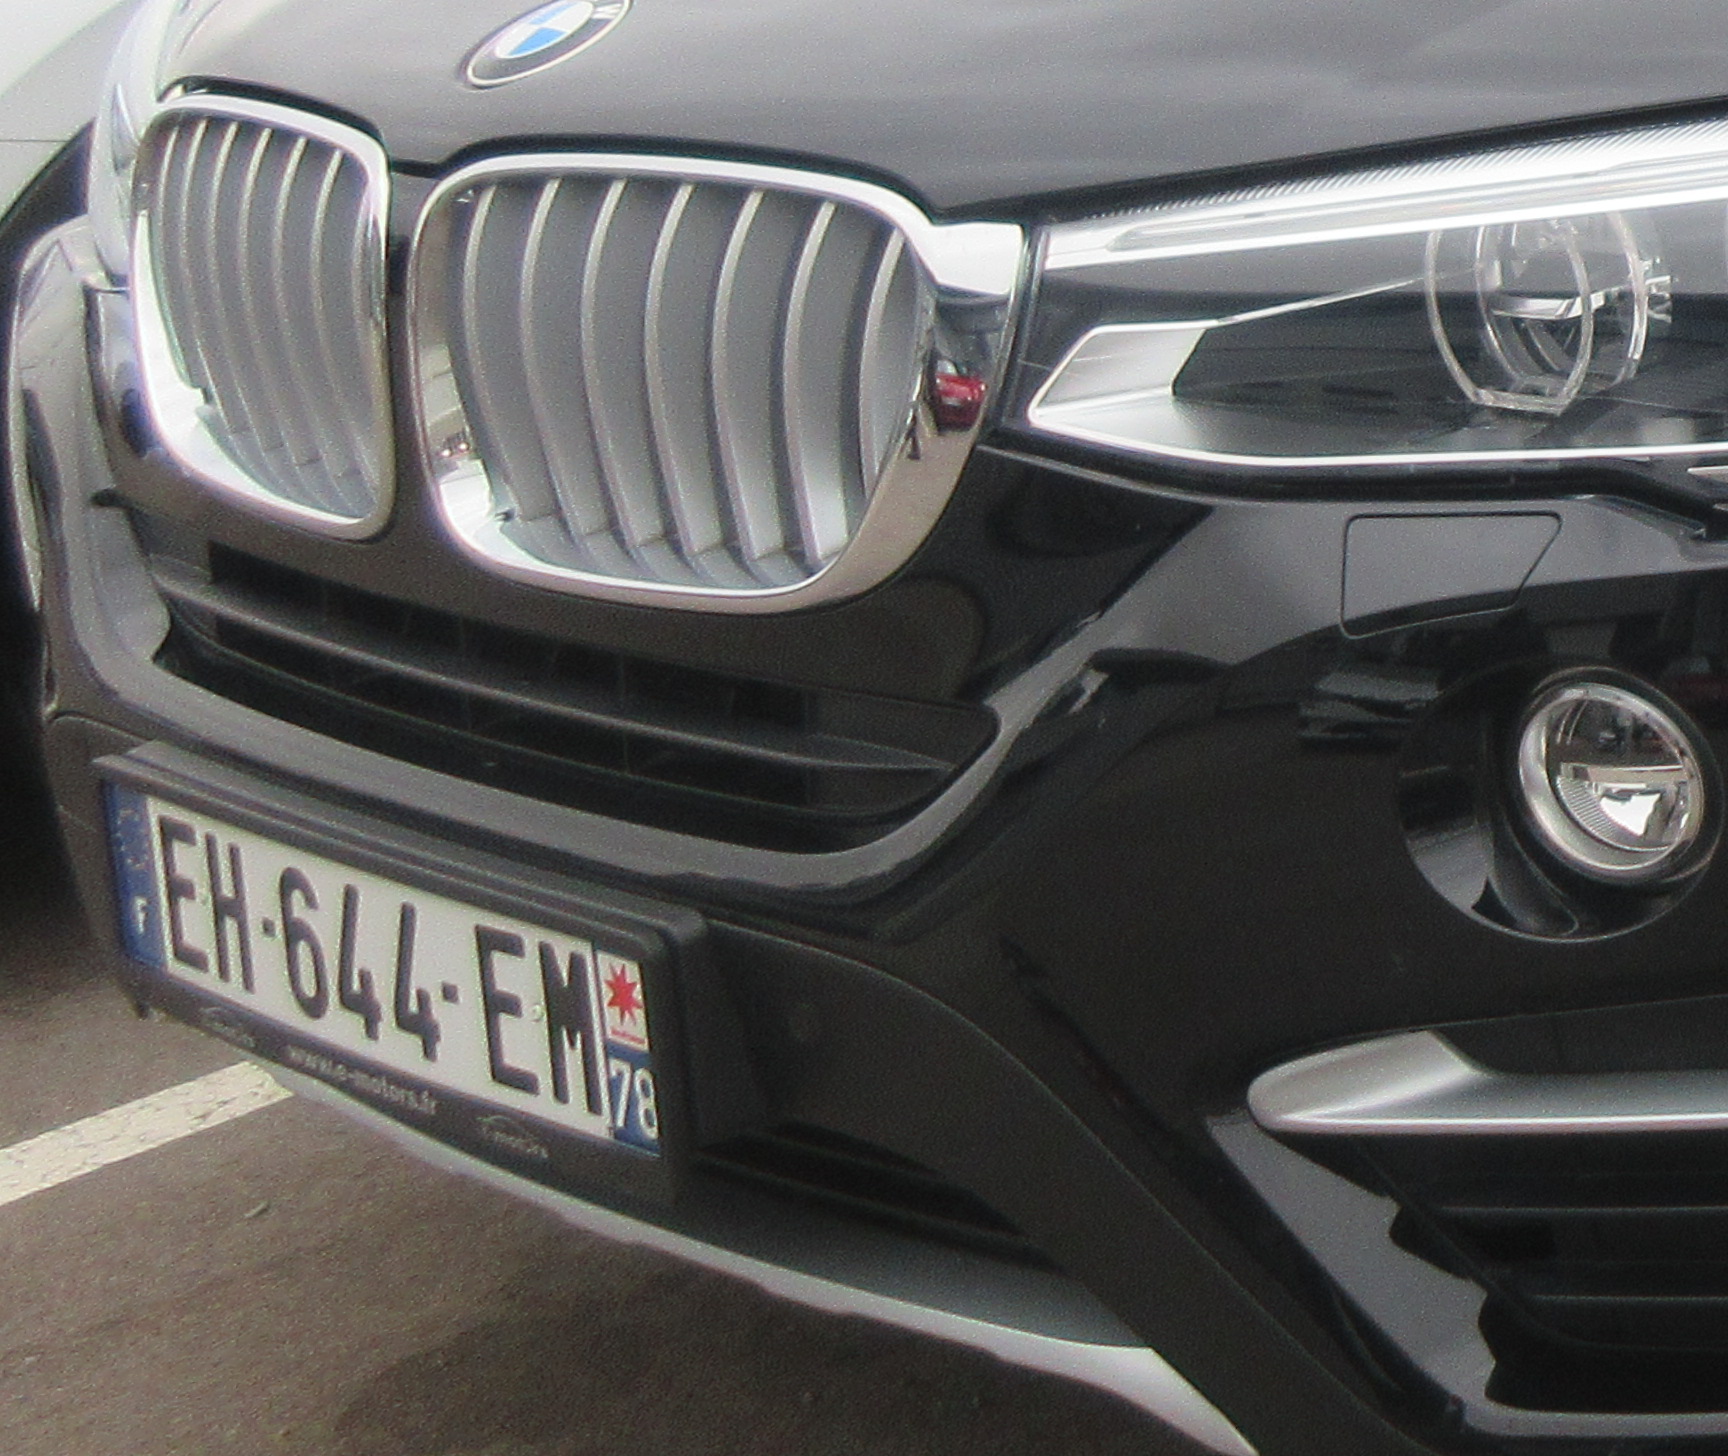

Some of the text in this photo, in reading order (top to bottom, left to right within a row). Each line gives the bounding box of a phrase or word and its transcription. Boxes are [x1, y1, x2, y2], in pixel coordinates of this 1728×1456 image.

[133, 895, 150, 935] F
[157, 813, 604, 1117] EH-644-EM
[609, 1056, 660, 1140] 78
